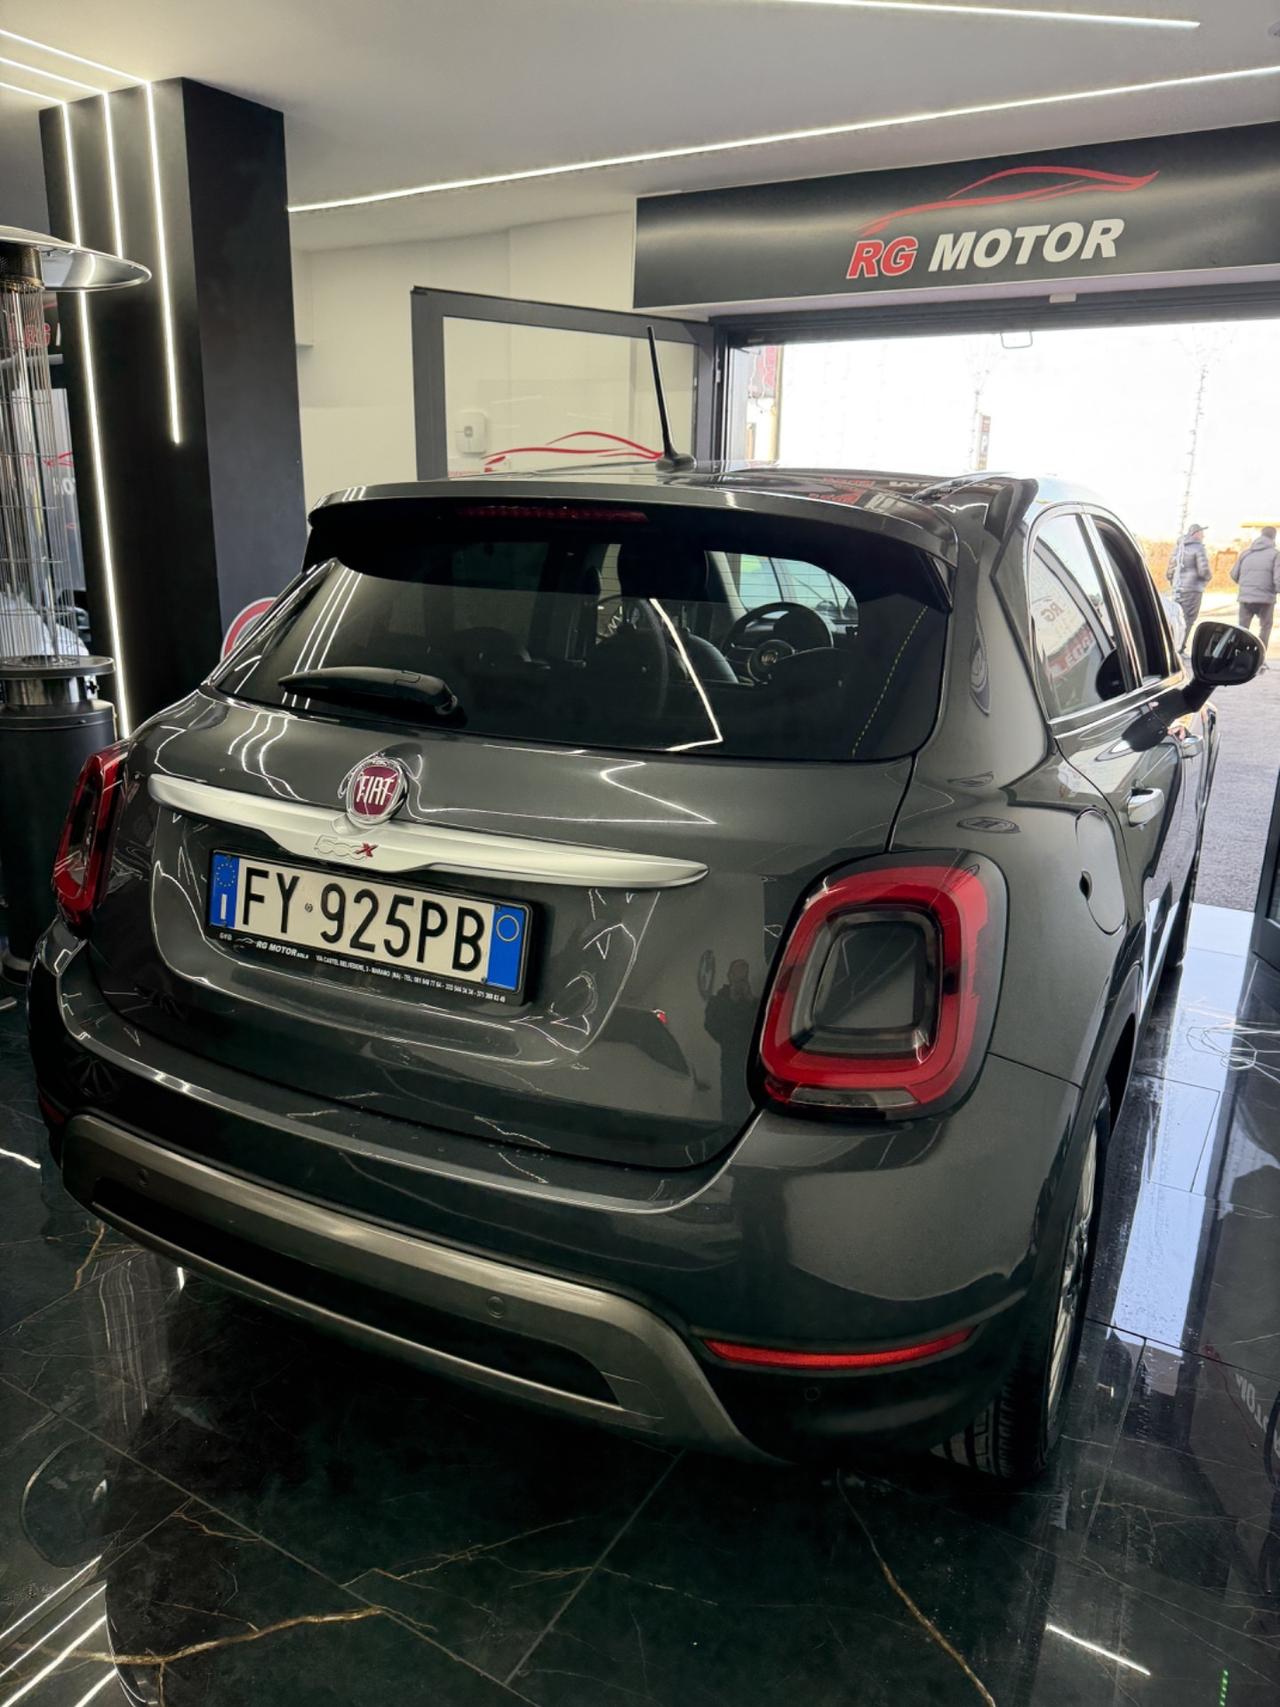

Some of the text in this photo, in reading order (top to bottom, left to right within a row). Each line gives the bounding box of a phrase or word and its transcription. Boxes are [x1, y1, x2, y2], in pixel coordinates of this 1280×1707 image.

[845, 218, 1126, 280] RG MOTOR
[356, 774, 395, 806] FIAT
[242, 866, 486, 973] FY 925PB
[268, 943, 297, 957] MOTOR
